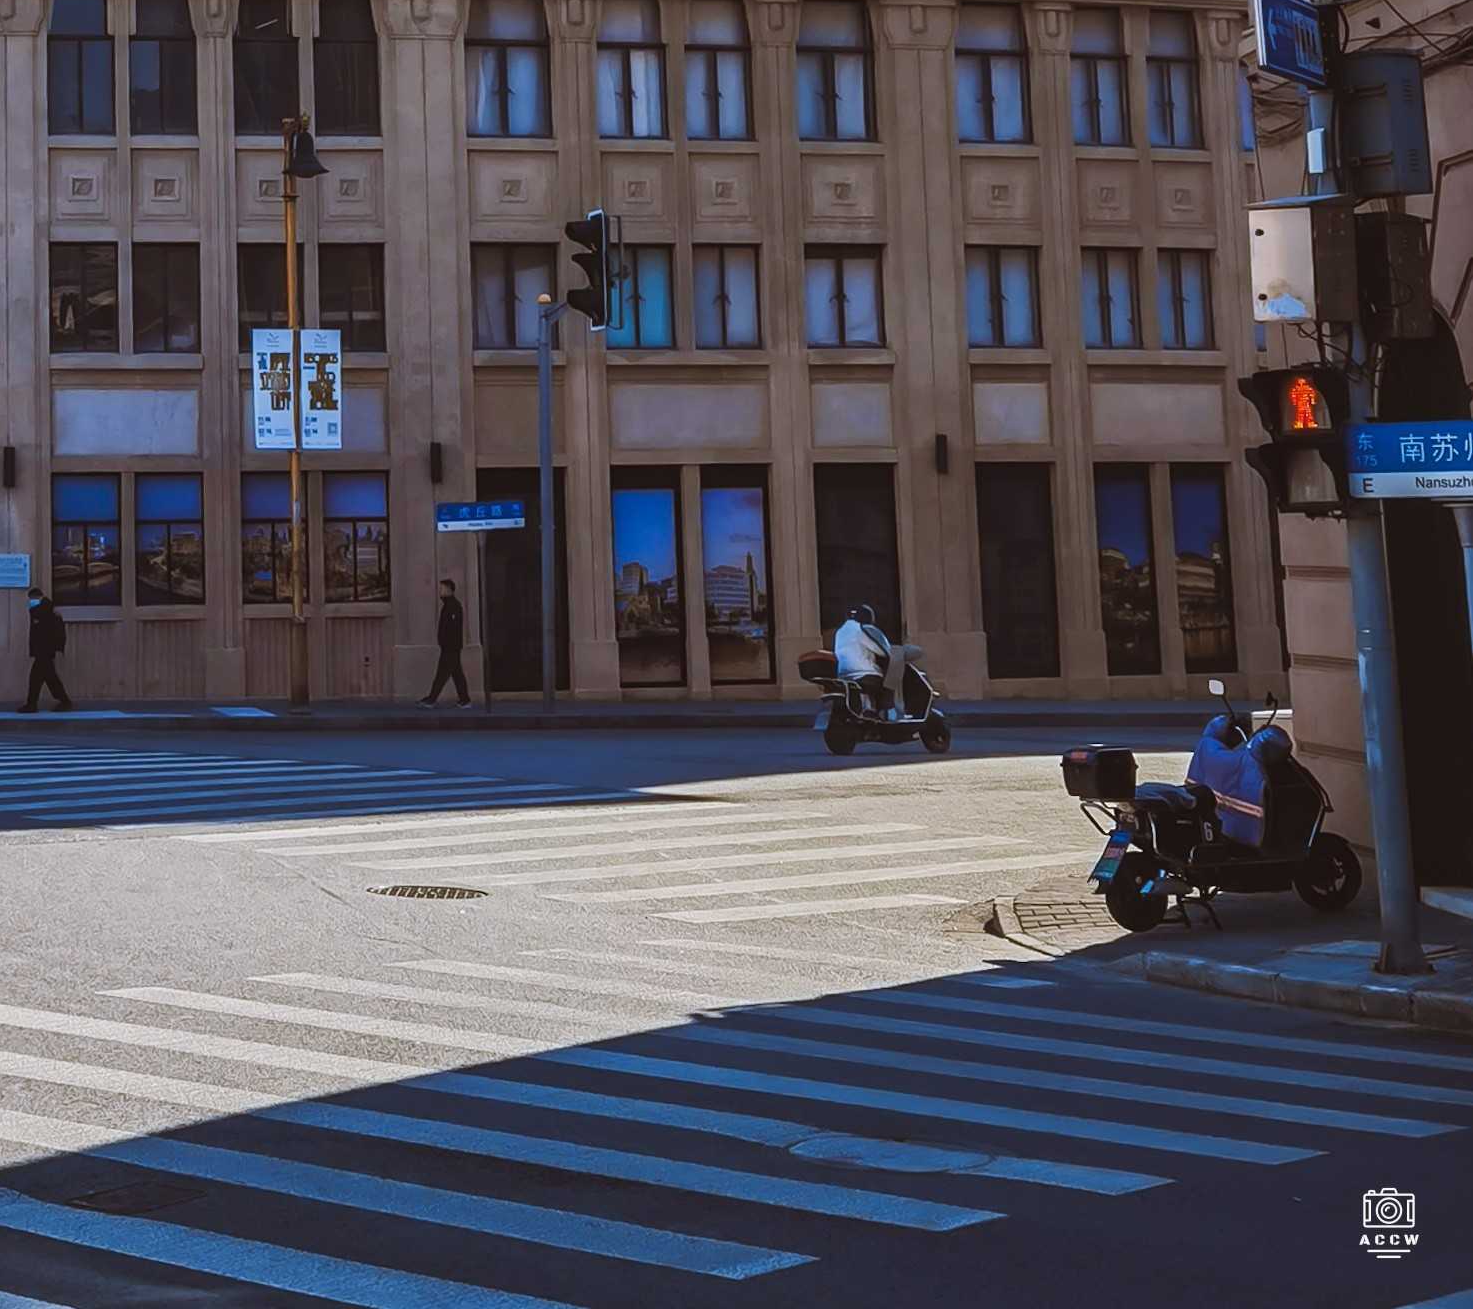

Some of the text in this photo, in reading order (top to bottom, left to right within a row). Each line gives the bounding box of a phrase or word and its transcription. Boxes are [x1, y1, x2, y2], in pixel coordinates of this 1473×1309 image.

[1358, 432, 1374, 451] 东
[1362, 477, 1374, 493] E
[1415, 476, 1473, 489] Nansuzh
